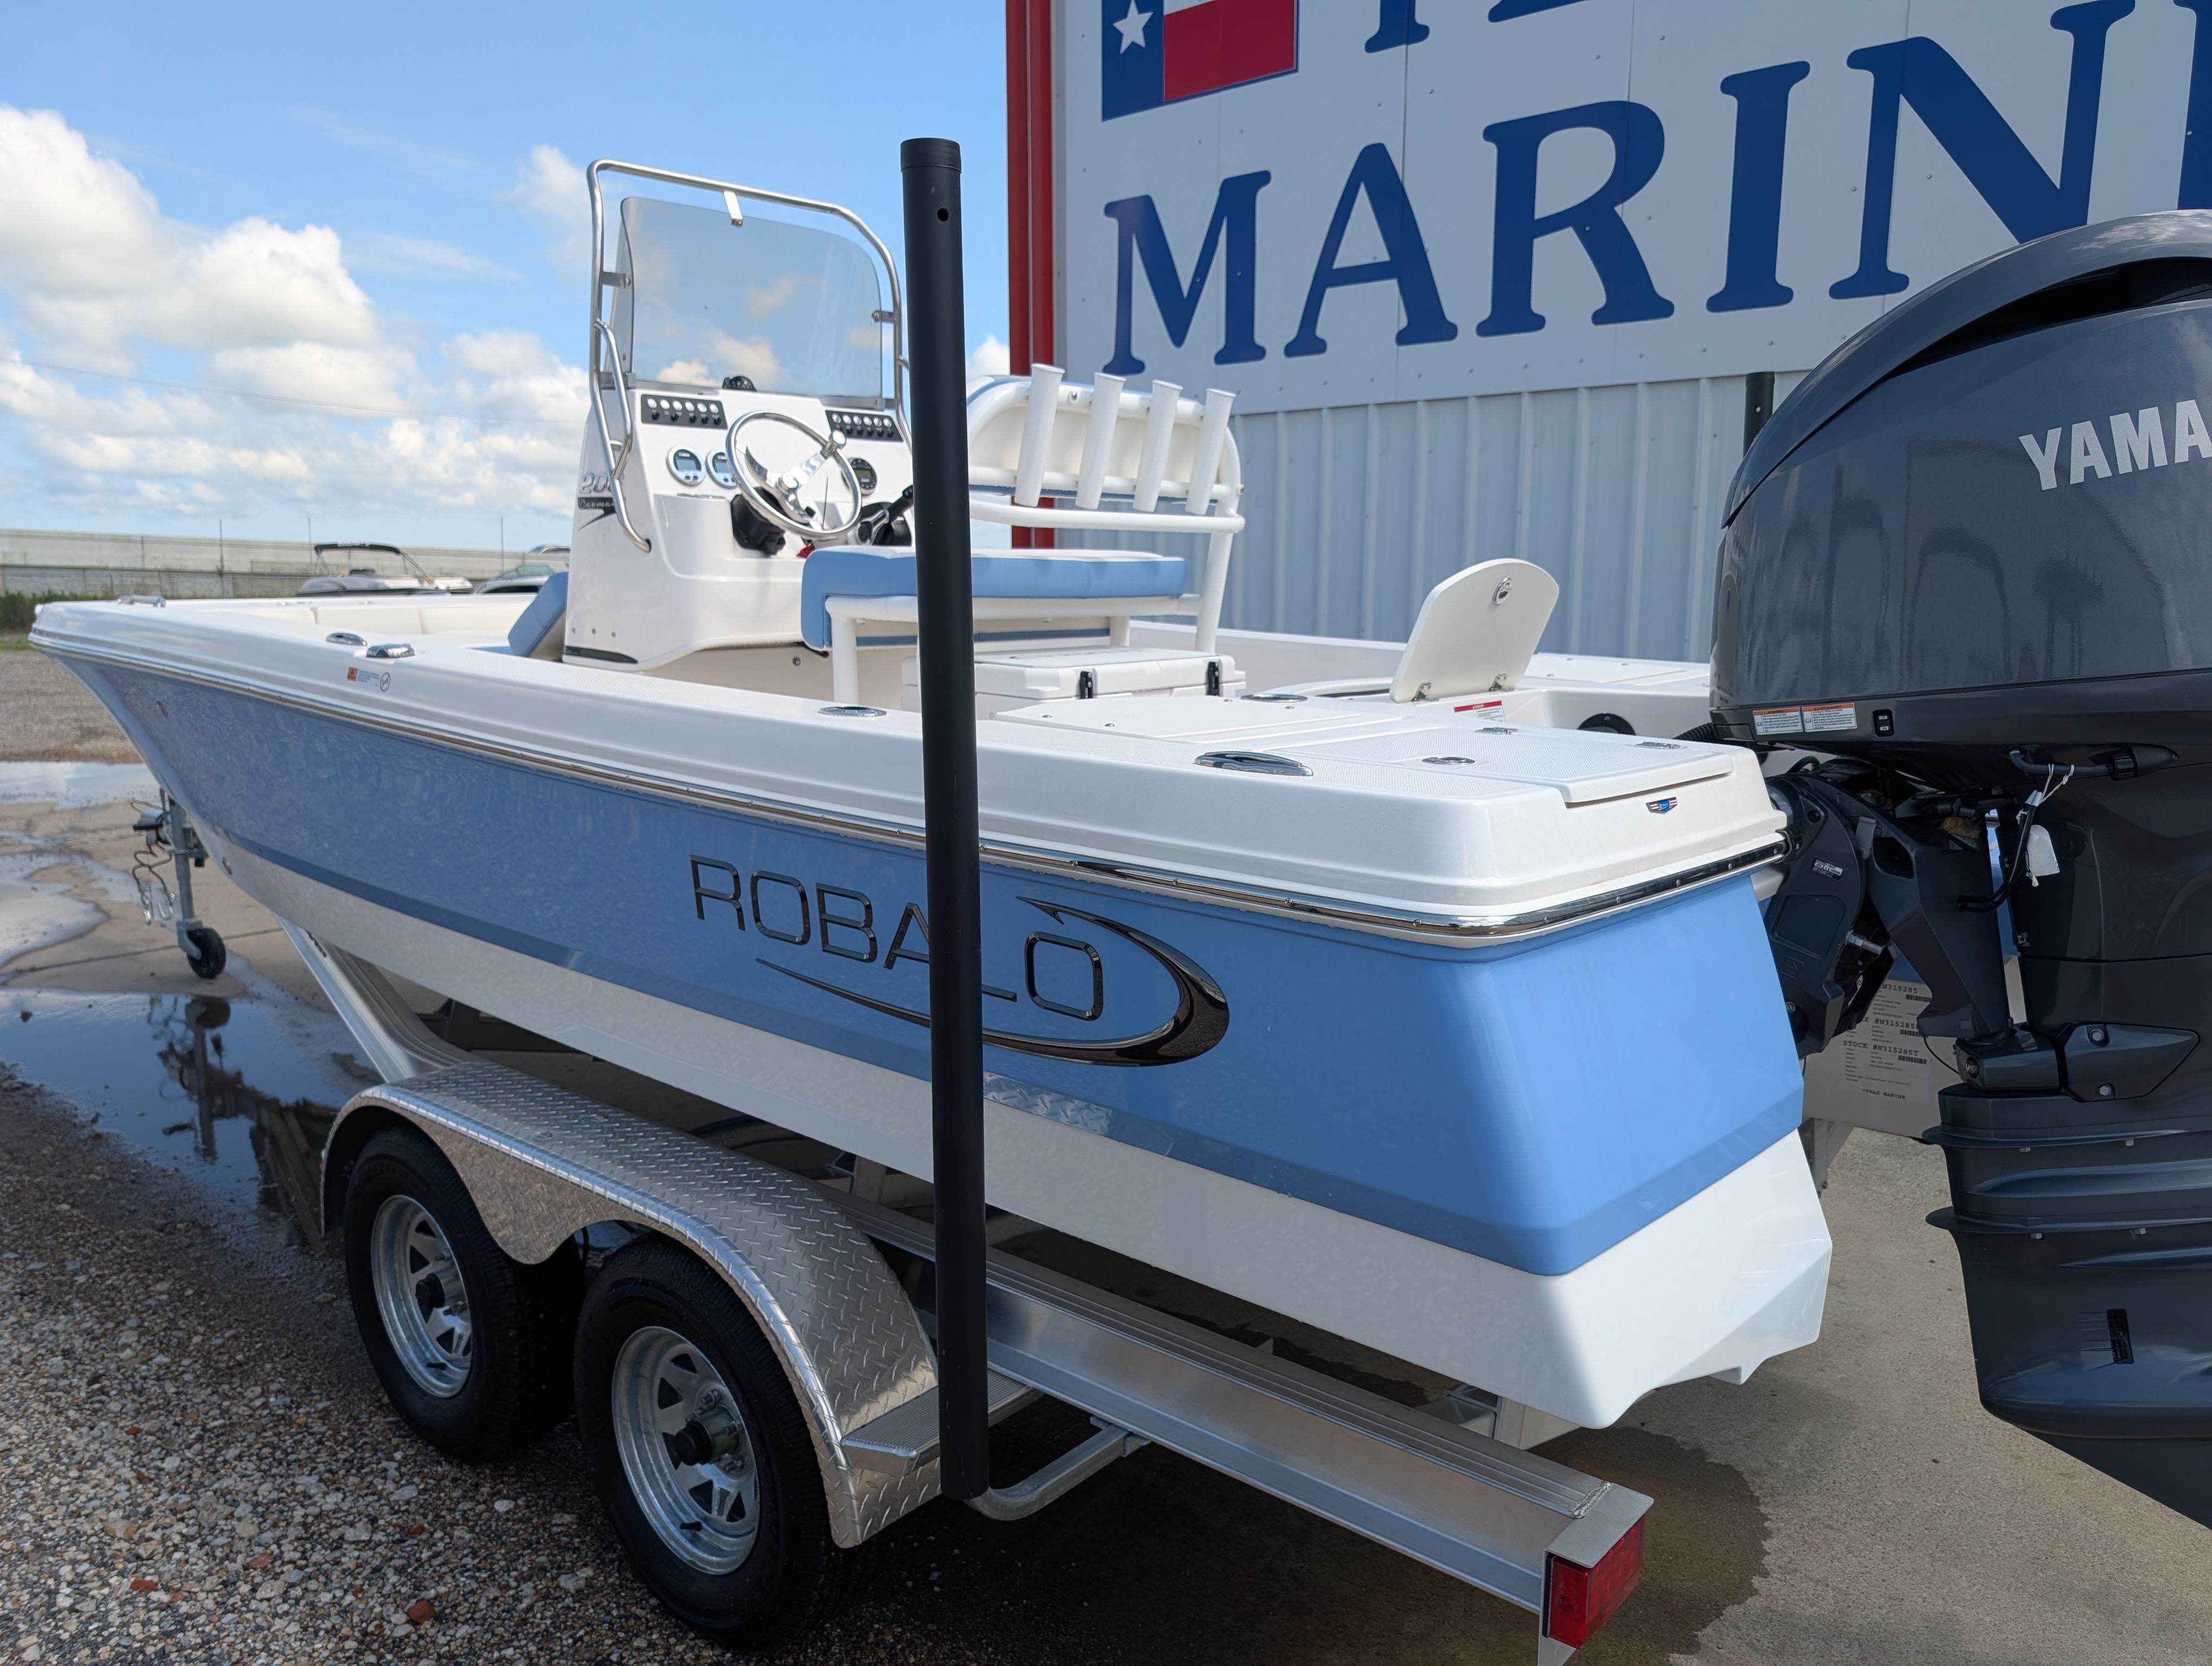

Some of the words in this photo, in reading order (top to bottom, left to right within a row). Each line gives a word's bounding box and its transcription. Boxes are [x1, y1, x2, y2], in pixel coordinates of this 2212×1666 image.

[1102, 0, 2212, 375] MARIN
[581, 471, 618, 494] 20
[690, 854, 1103, 1022] ROBAO
[1882, 984, 1918, 994] N315285
[1843, 1040, 1868, 1049] STOCK
[1873, 1045, 1919, 1056] #N315285T
